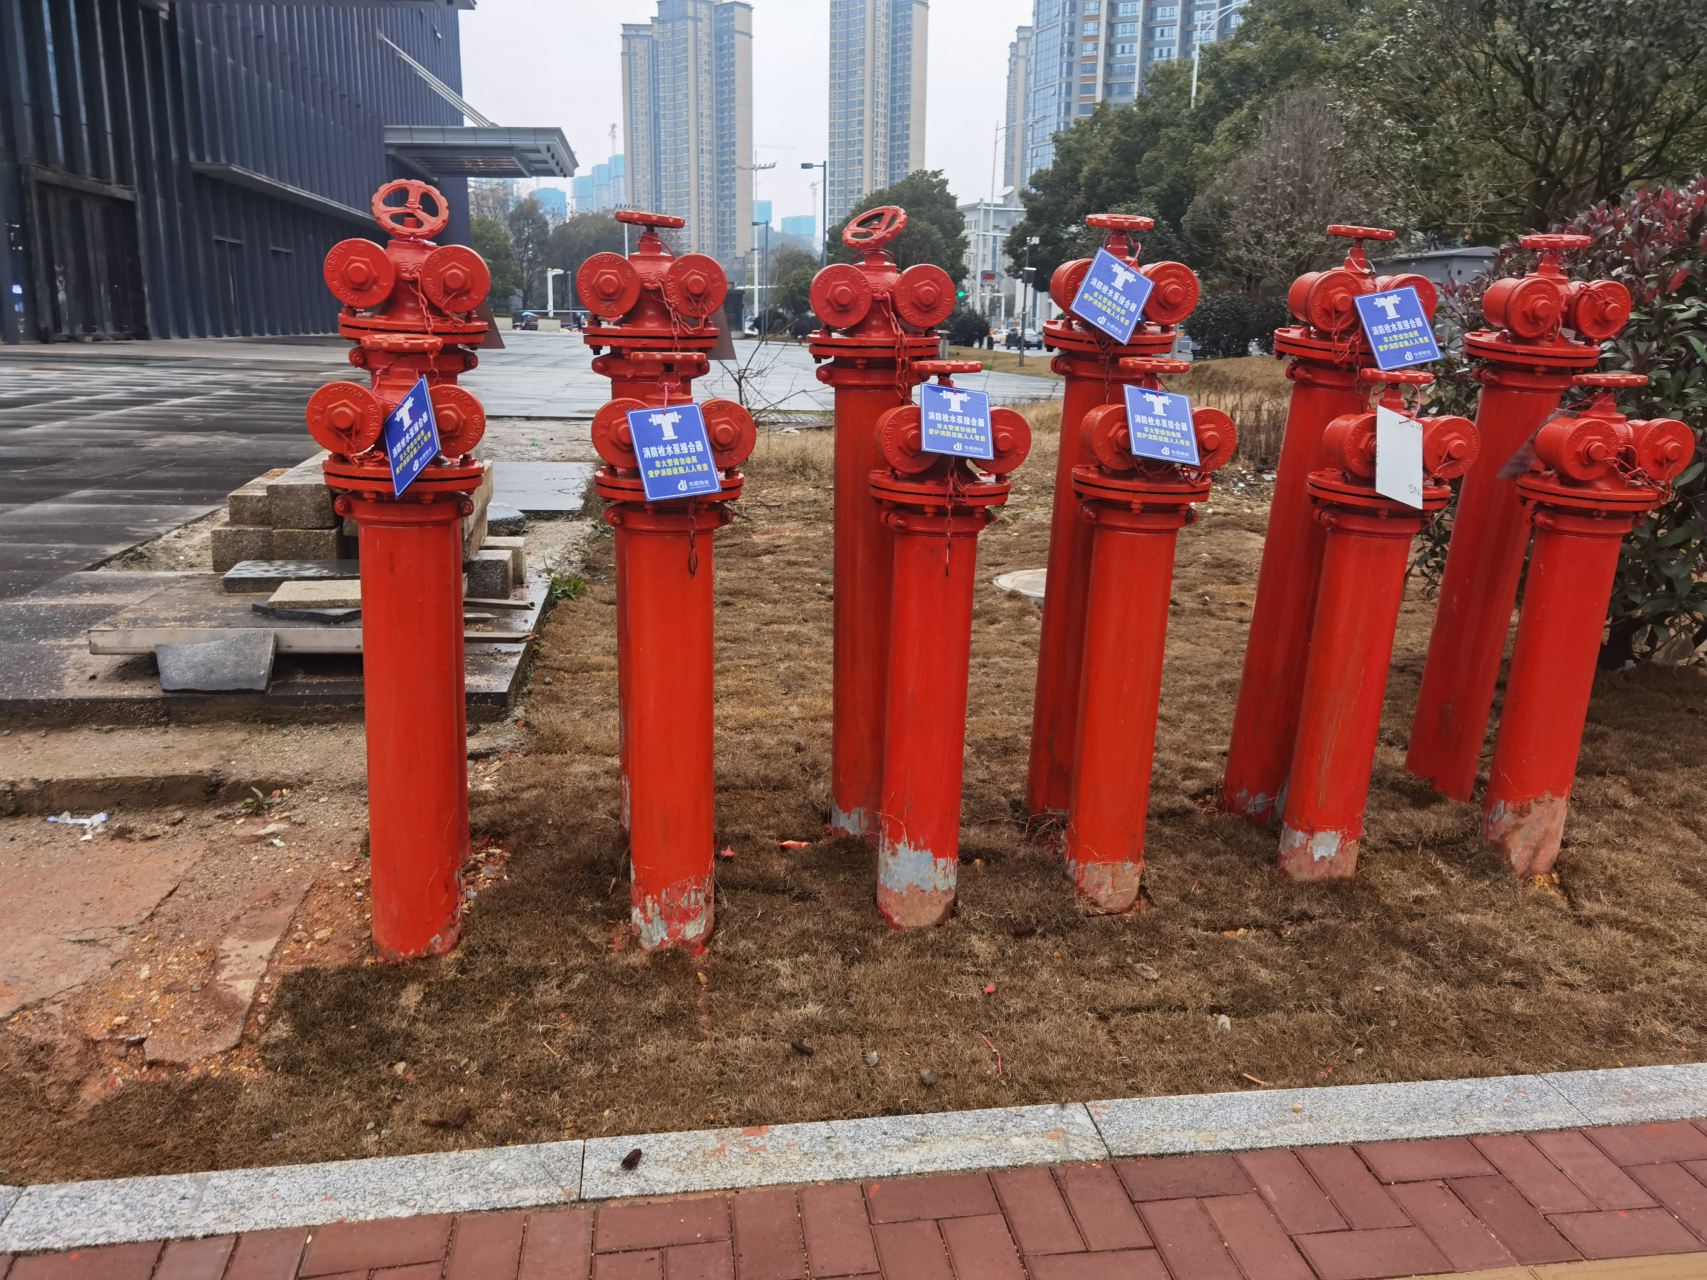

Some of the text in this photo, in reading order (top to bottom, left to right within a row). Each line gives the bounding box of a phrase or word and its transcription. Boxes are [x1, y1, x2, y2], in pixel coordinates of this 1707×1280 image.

[1089, 277, 1137, 312] 消防栓水泵接合器
[1083, 292, 1129, 326] 爱护消防设施人人有责
[1371, 317, 1423, 336] 消防栓水泵接合器
[1378, 336, 1430, 352] 爱护消防设施人人有责
[927, 411, 985, 427] 消防栓水泵接合器
[1134, 414, 1188, 432] 消防栓水泵接合器
[392, 411, 428, 458] 消防栓水泵接合器
[928, 428, 986, 442] 爱护消防设施人人有责
[936, 423, 977, 434] 非火警请勿动用
[1136, 431, 1190, 447] 爱护消防设施人人有责
[642, 440, 703, 459] 消防栓水泵接合器
[654, 455, 698, 468] 非火警请勿动用
[647, 463, 709, 478] 爱护消防设施人人有责
